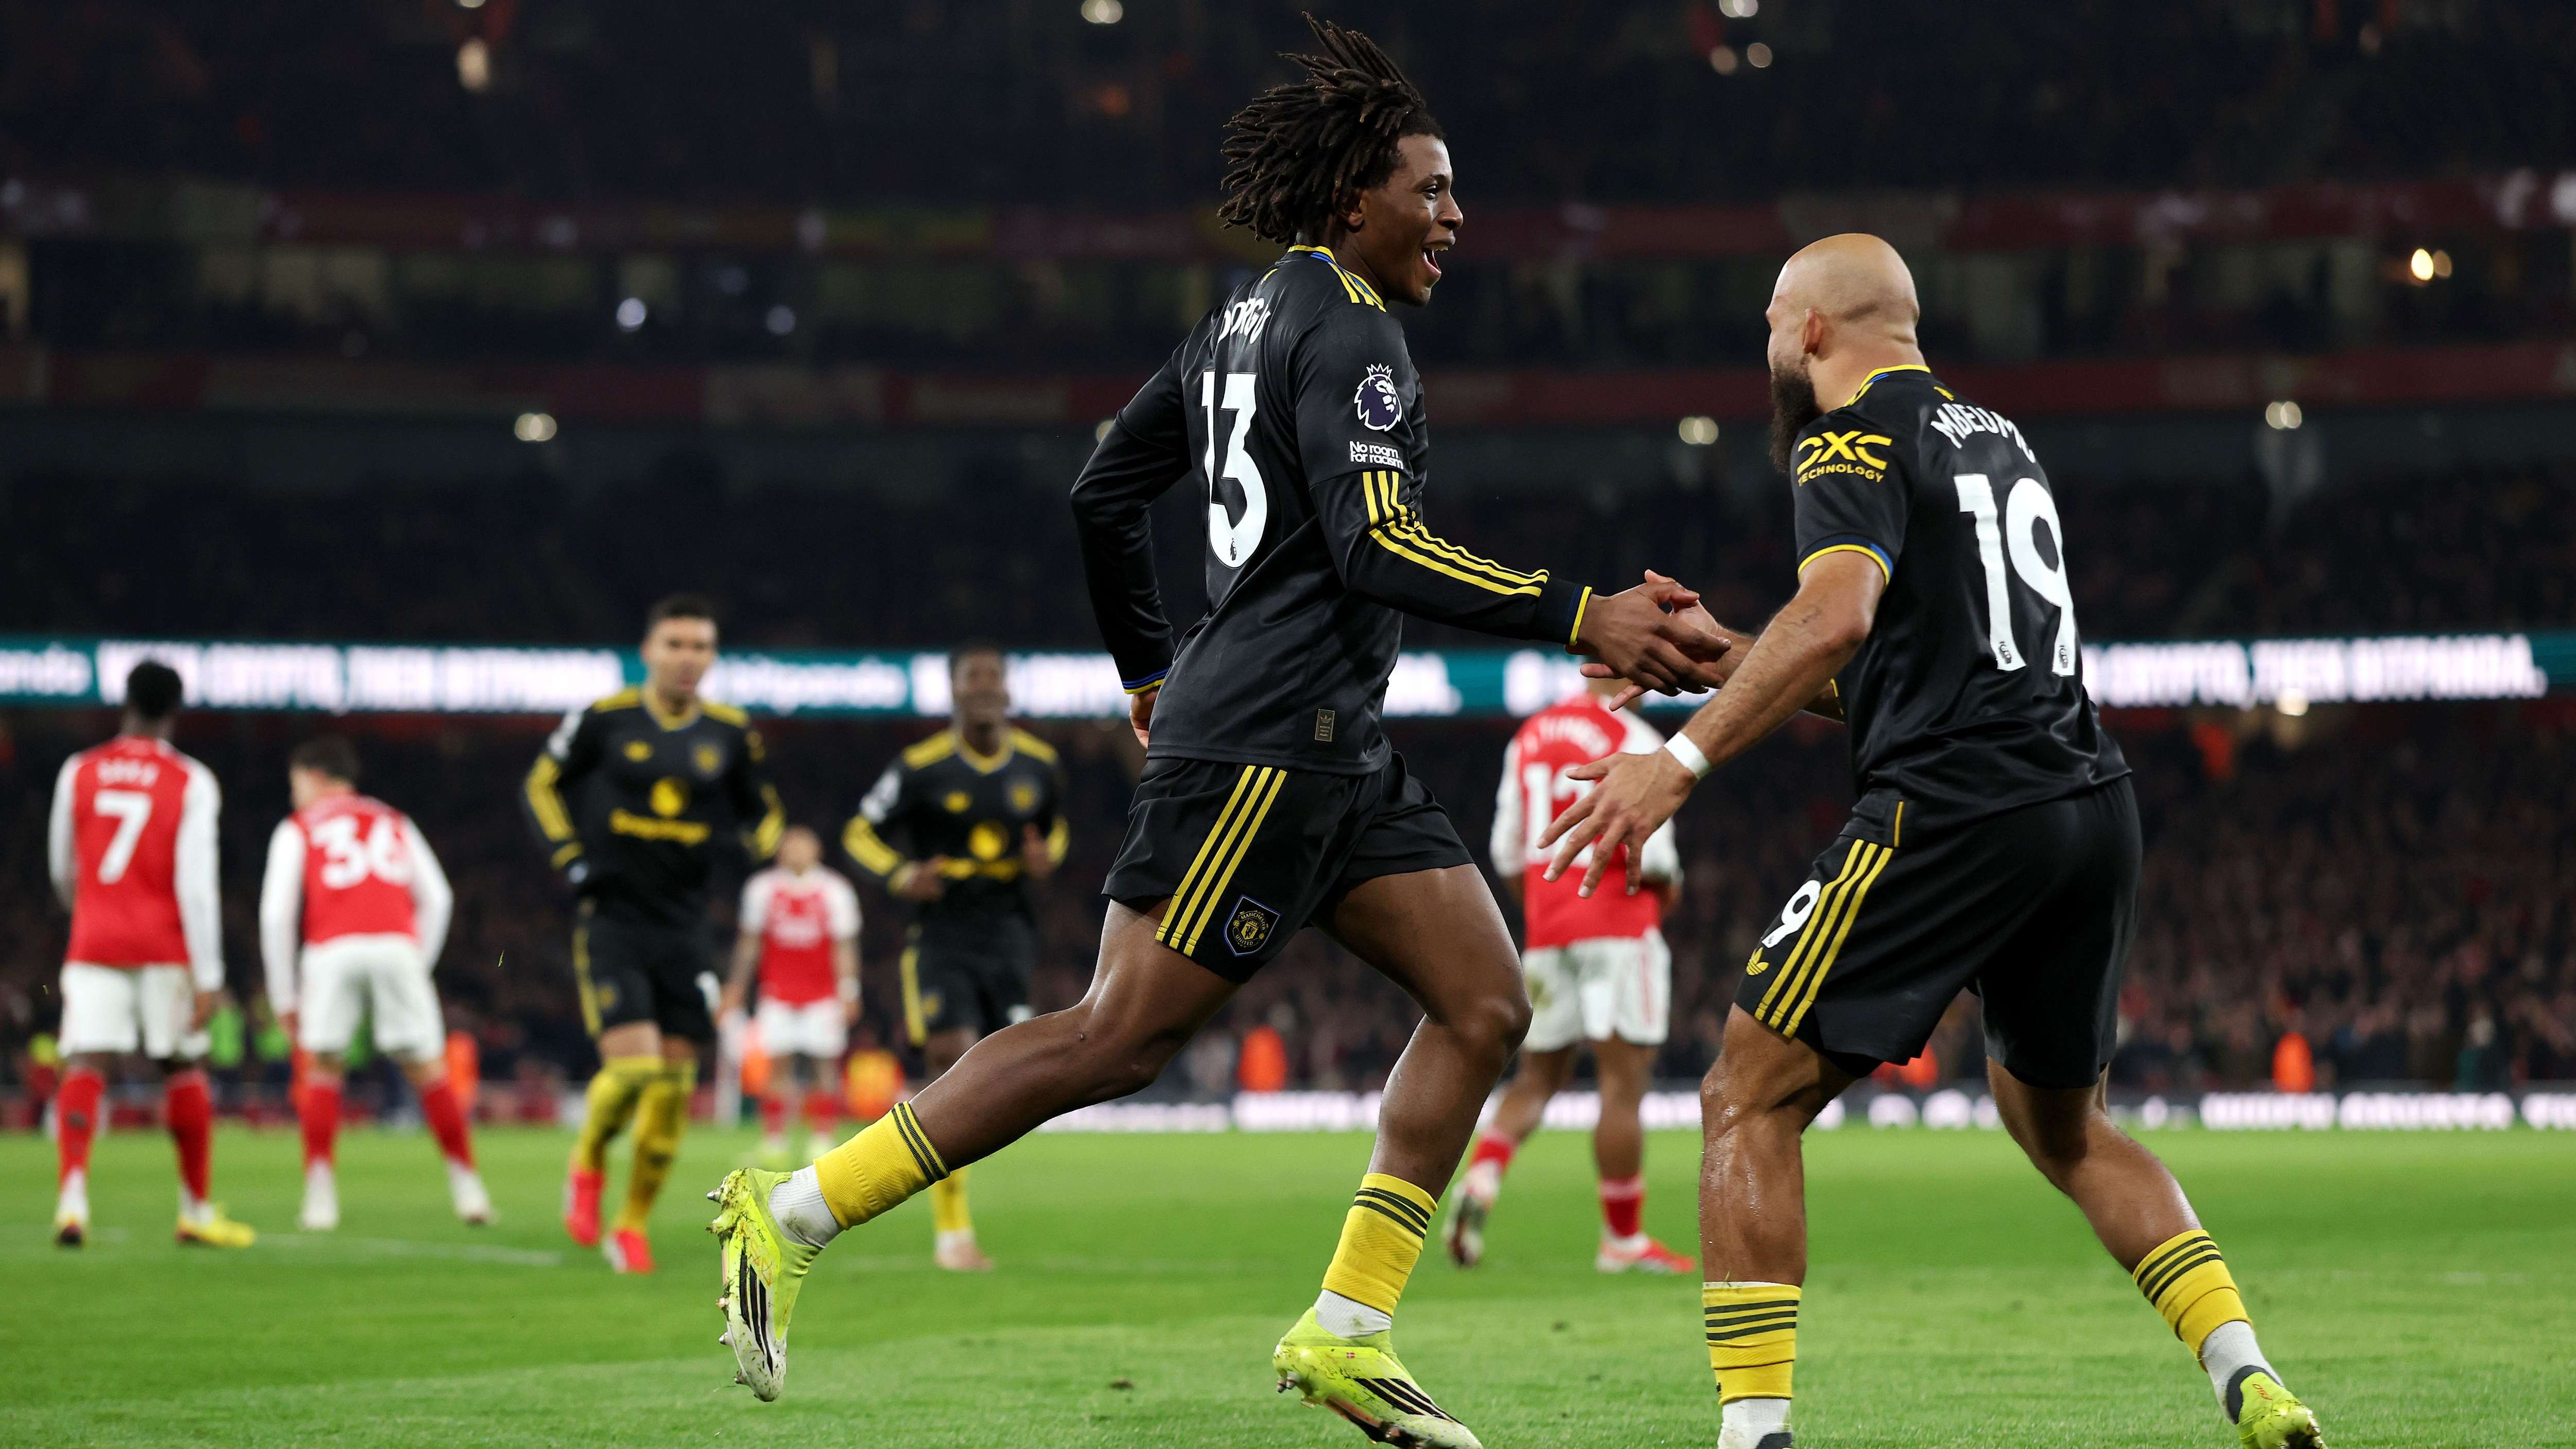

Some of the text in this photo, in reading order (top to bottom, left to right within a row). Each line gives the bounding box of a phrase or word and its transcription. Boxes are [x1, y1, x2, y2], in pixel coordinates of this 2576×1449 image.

[1349, 441, 1399, 459] No room
[1350, 451, 1404, 469] for racism
[1201, 369, 1267, 568] 13
[1798, 464, 1883, 486] TECHNOLOGY
[1954, 473, 2075, 677] 19
[94, 788, 153, 885] 7
[1240, 912, 1266, 931] MANCHESTER
[1235, 934, 1254, 946] UNITED
